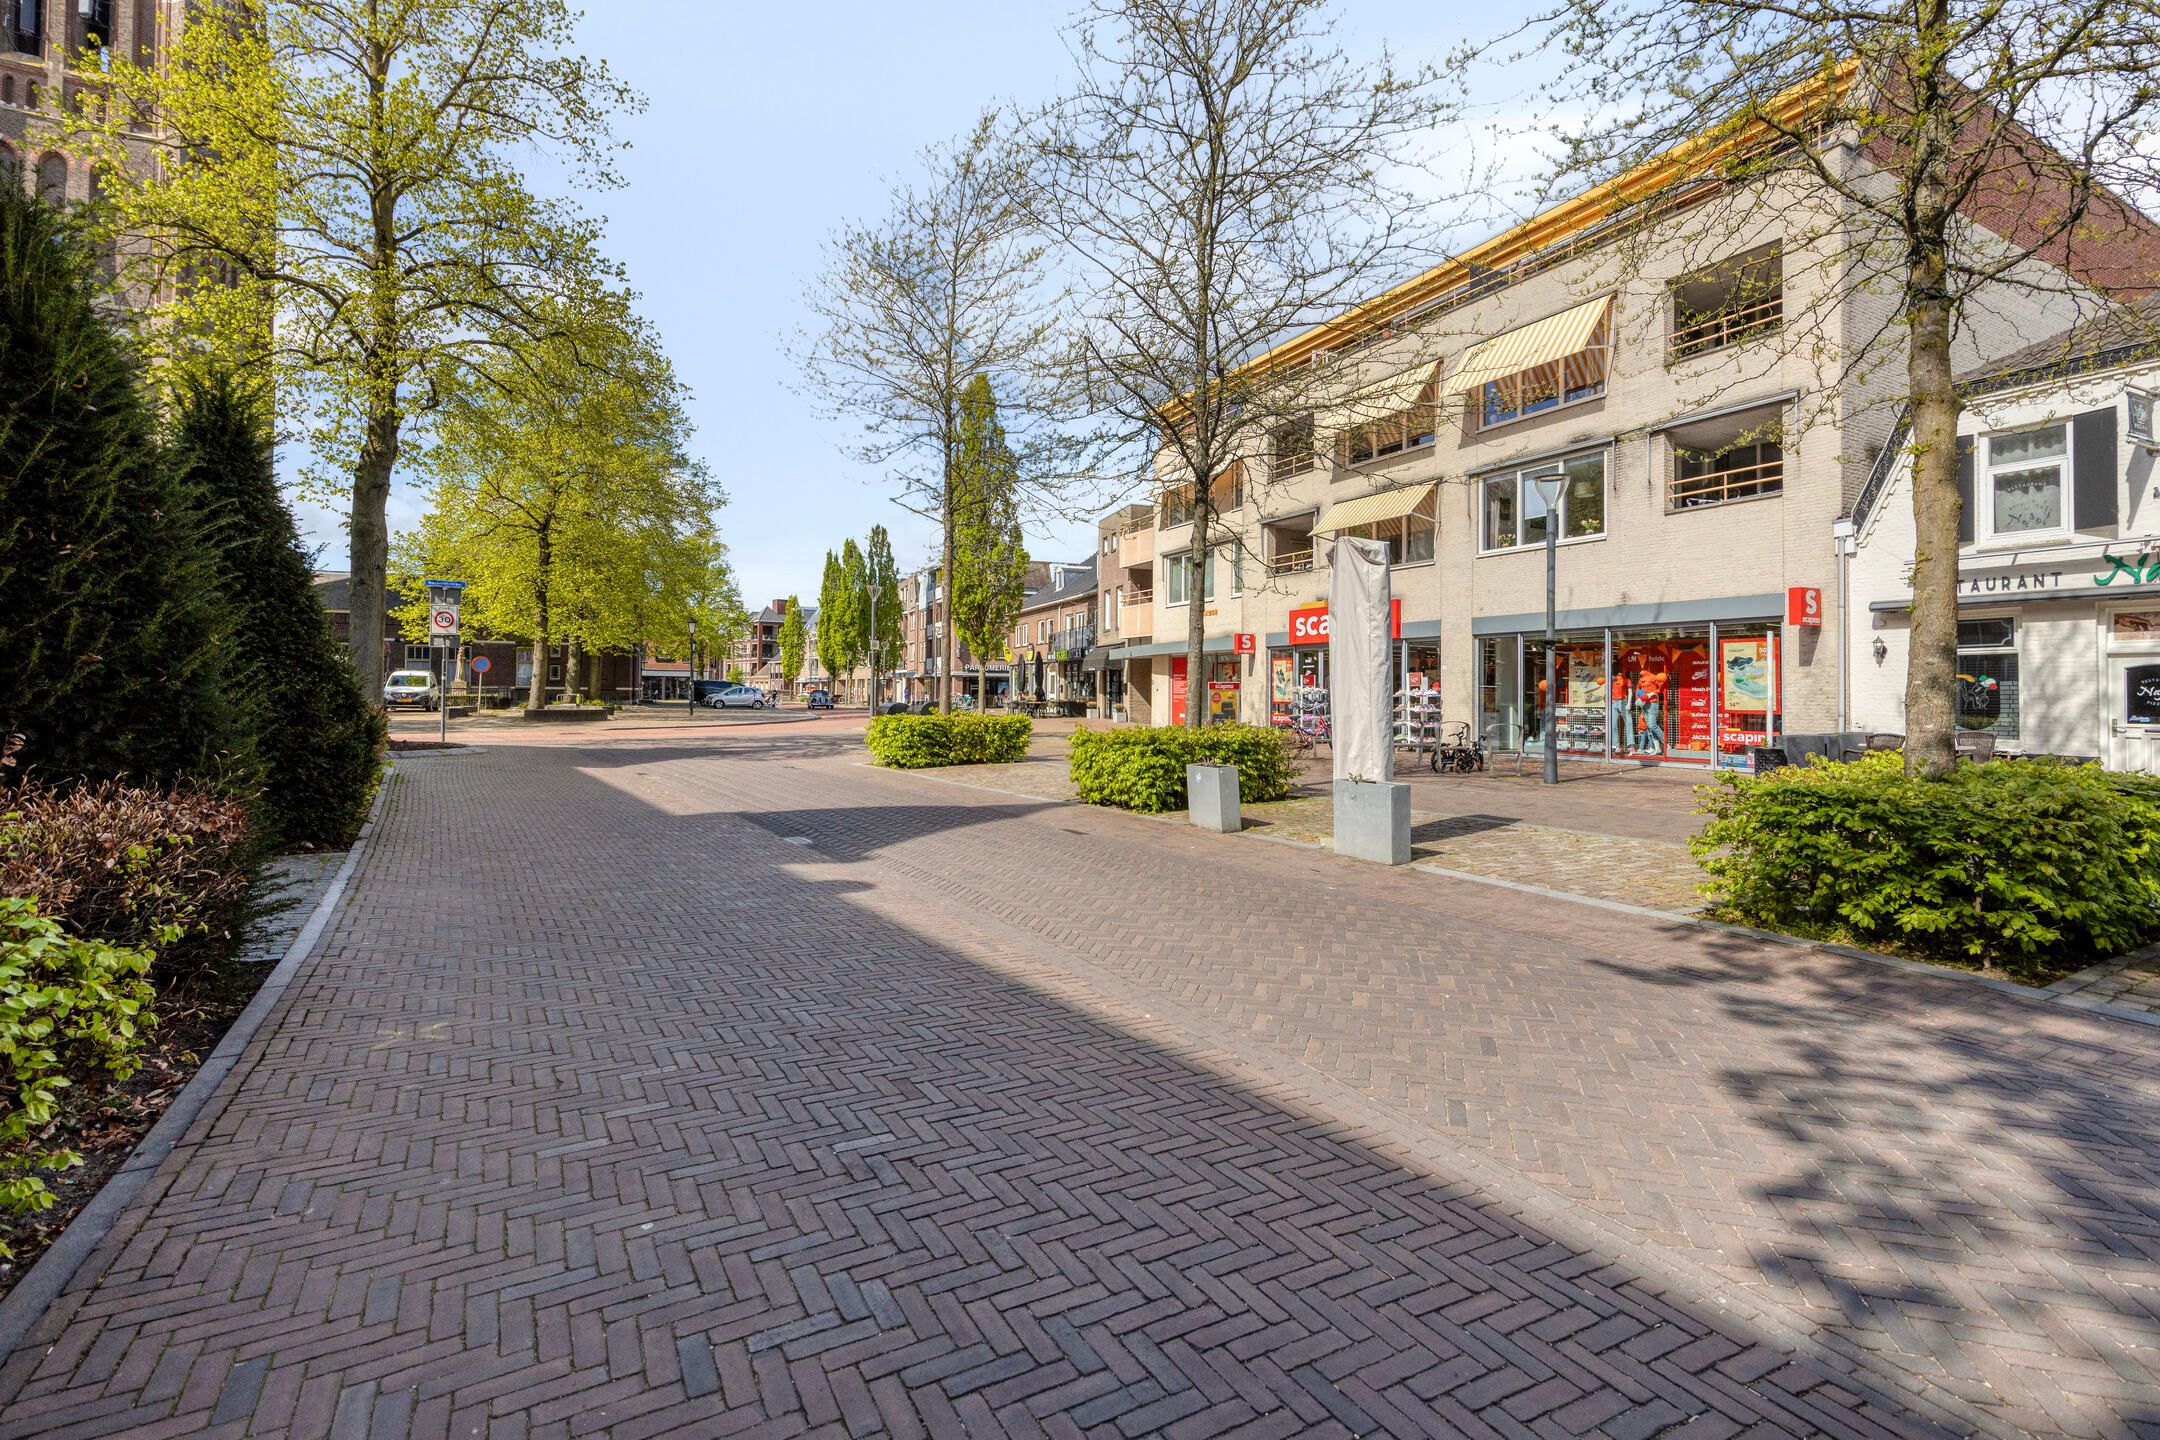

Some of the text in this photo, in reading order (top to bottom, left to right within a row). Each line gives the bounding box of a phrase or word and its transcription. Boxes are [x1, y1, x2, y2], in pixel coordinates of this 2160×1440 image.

[1805, 589, 1817, 615] S
[438, 616, 451, 624] 30
[1241, 634, 1251, 649] S
[964, 664, 1011, 672] PARUMERIE
